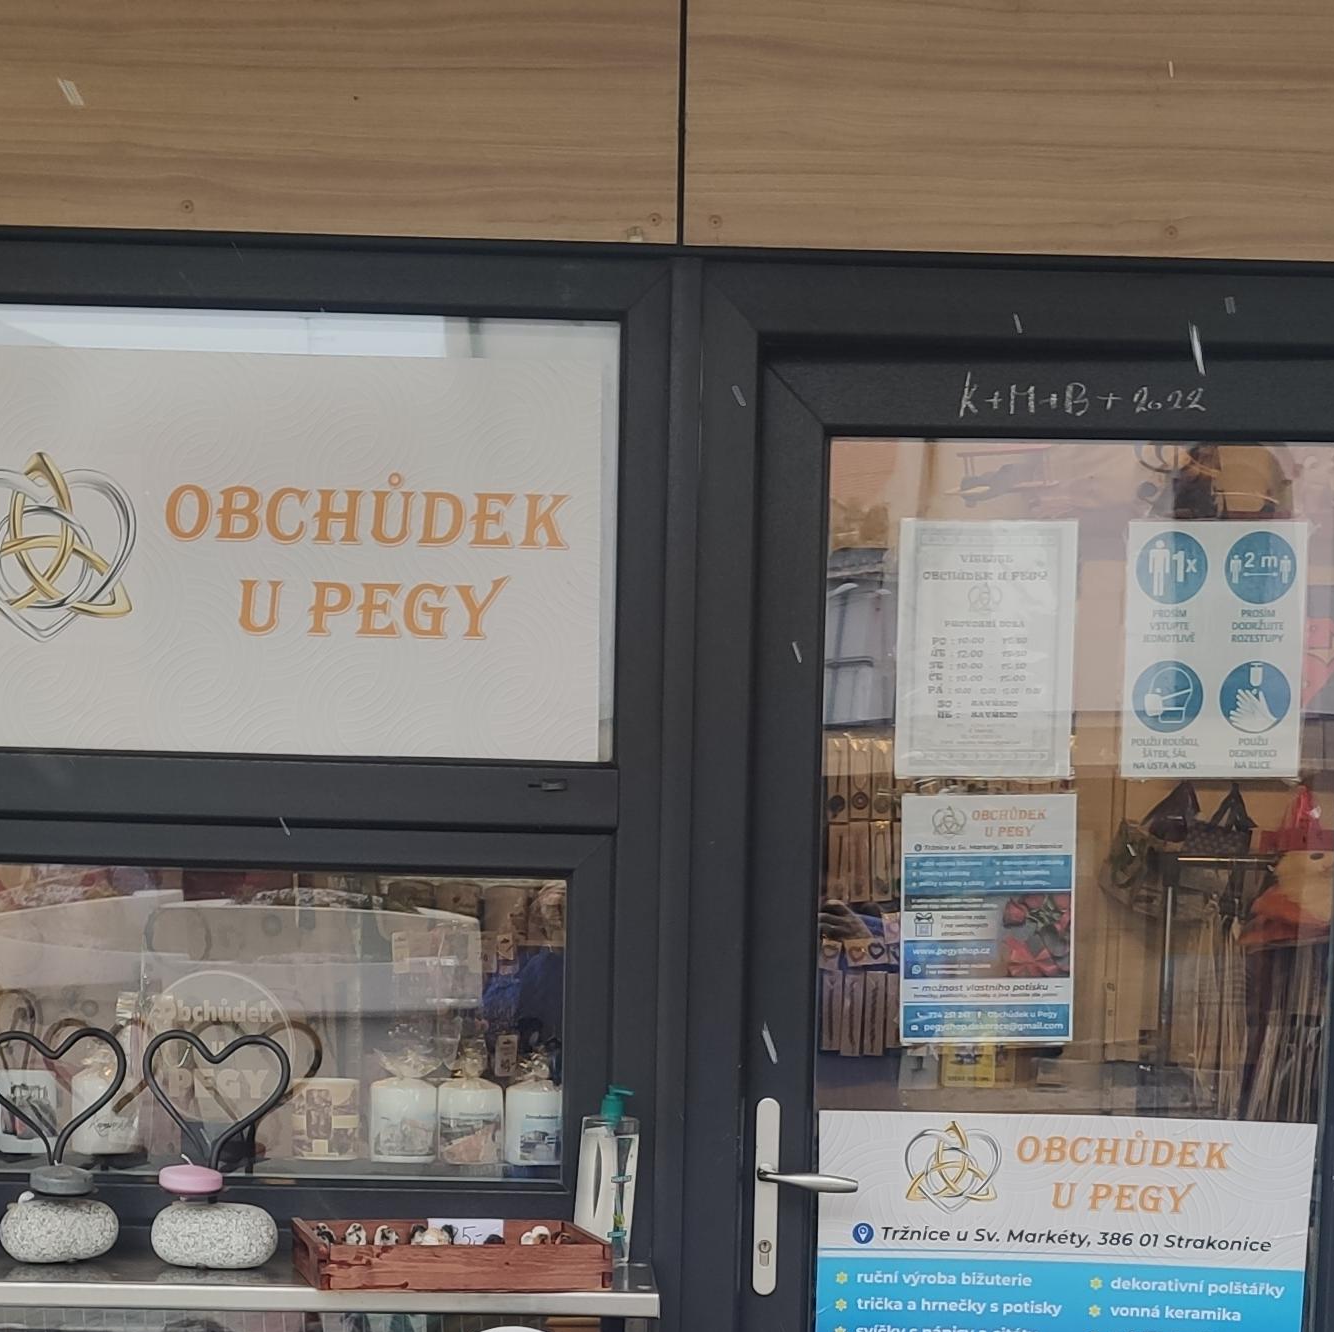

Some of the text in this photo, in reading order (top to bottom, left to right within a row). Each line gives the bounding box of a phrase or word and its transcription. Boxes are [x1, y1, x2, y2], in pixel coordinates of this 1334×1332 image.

[166, 471, 571, 550] OBCHŮDEK
[1244, 553, 1278, 568] 2 m
[238, 576, 511, 641] U PEGY
[972, 807, 1047, 822] OBCHŮDEK
[985, 825, 1035, 837] U PEGY
[1016, 1130, 1233, 1170] OBCHŮDEK
[1051, 1182, 1196, 1215] U PEGY
[881, 1225, 1272, 1253] Tržnice u Sv. Markéty, 386 01 Strakonice
[857, 1270, 1032, 1289] ruční výroba bižuterie
[1110, 1275, 1286, 1300] dekorativní polštářky
[857, 1296, 1062, 1318] trička a hrnečky s potisky
[1110, 1304, 1241, 1322] vonná keramika
